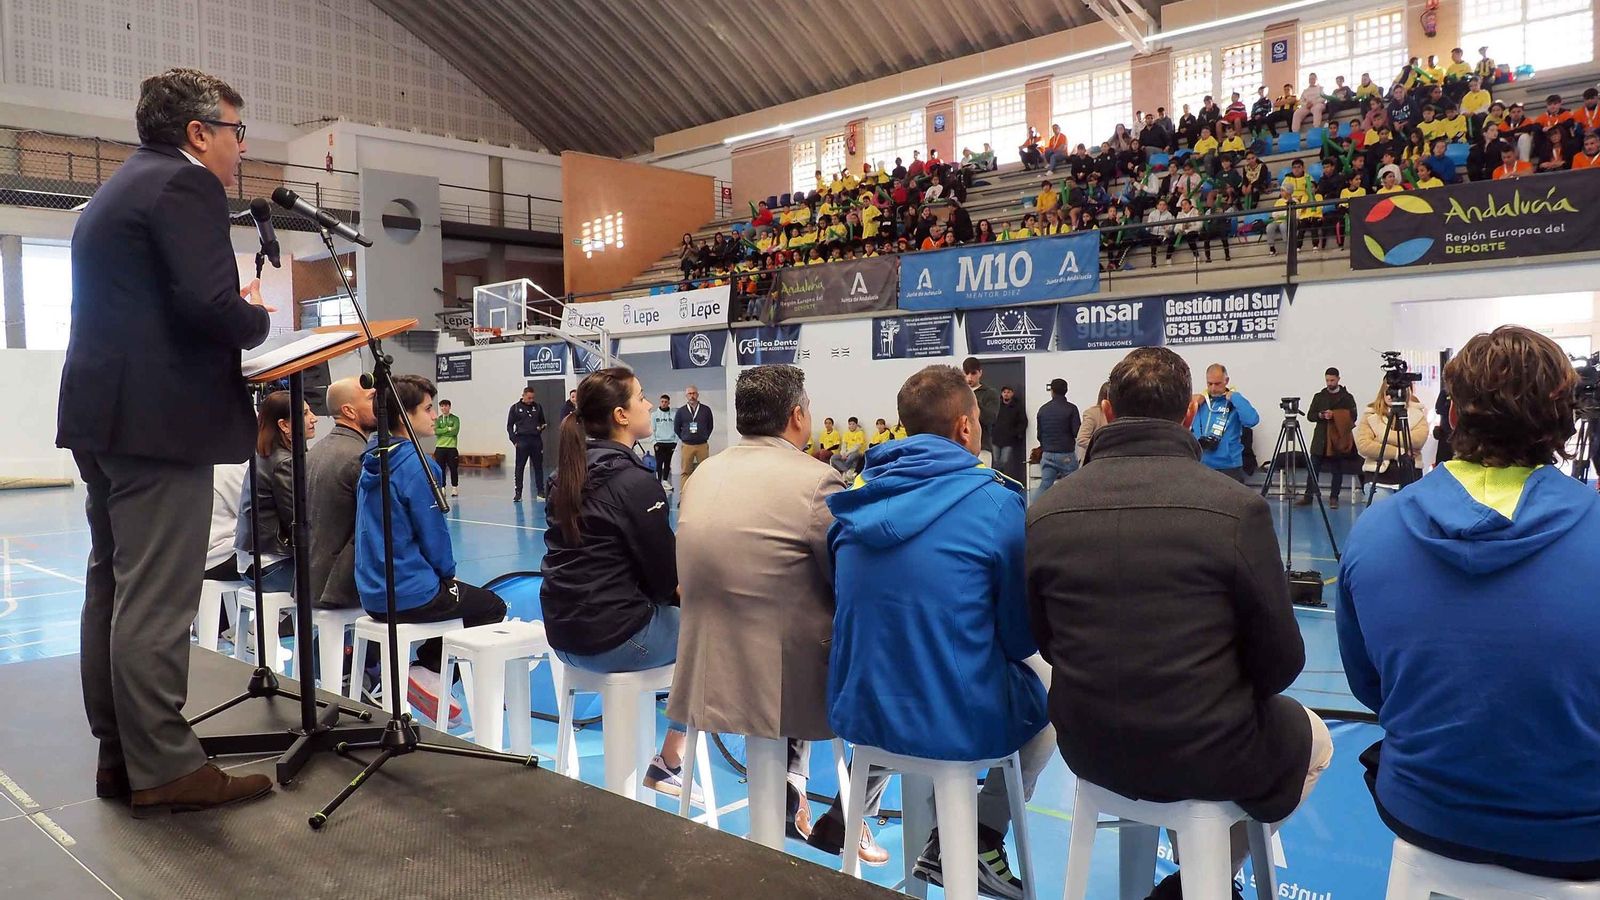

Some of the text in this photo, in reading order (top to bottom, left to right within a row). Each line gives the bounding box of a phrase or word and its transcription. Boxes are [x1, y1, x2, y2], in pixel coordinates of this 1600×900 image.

[1444, 186, 1579, 224] Andalucía
[1445, 223, 1565, 244] Región Europea del
[1445, 241, 1506, 254] DEPORTE
[955, 250, 1033, 292] M10
[966, 288, 1021, 299] MENTOR DIEZ
[691, 302, 721, 319] Lepe
[1165, 292, 1280, 316] Gestión del Sur
[443, 315, 469, 327] Lepe
[633, 309, 660, 326] Lepe
[1075, 302, 1143, 324] ansar
[1165, 314, 1221, 323] INMOBILIARIA
[1229, 309, 1279, 319] FINANCIERA
[578, 314, 605, 329] Lepe
[1165, 316, 1278, 337] 635 937 535
[774, 339, 798, 347] Denta
[987, 337, 1036, 346] EUROPROYECTOS
[1087, 340, 1132, 348] DISTRIBUCIONES
